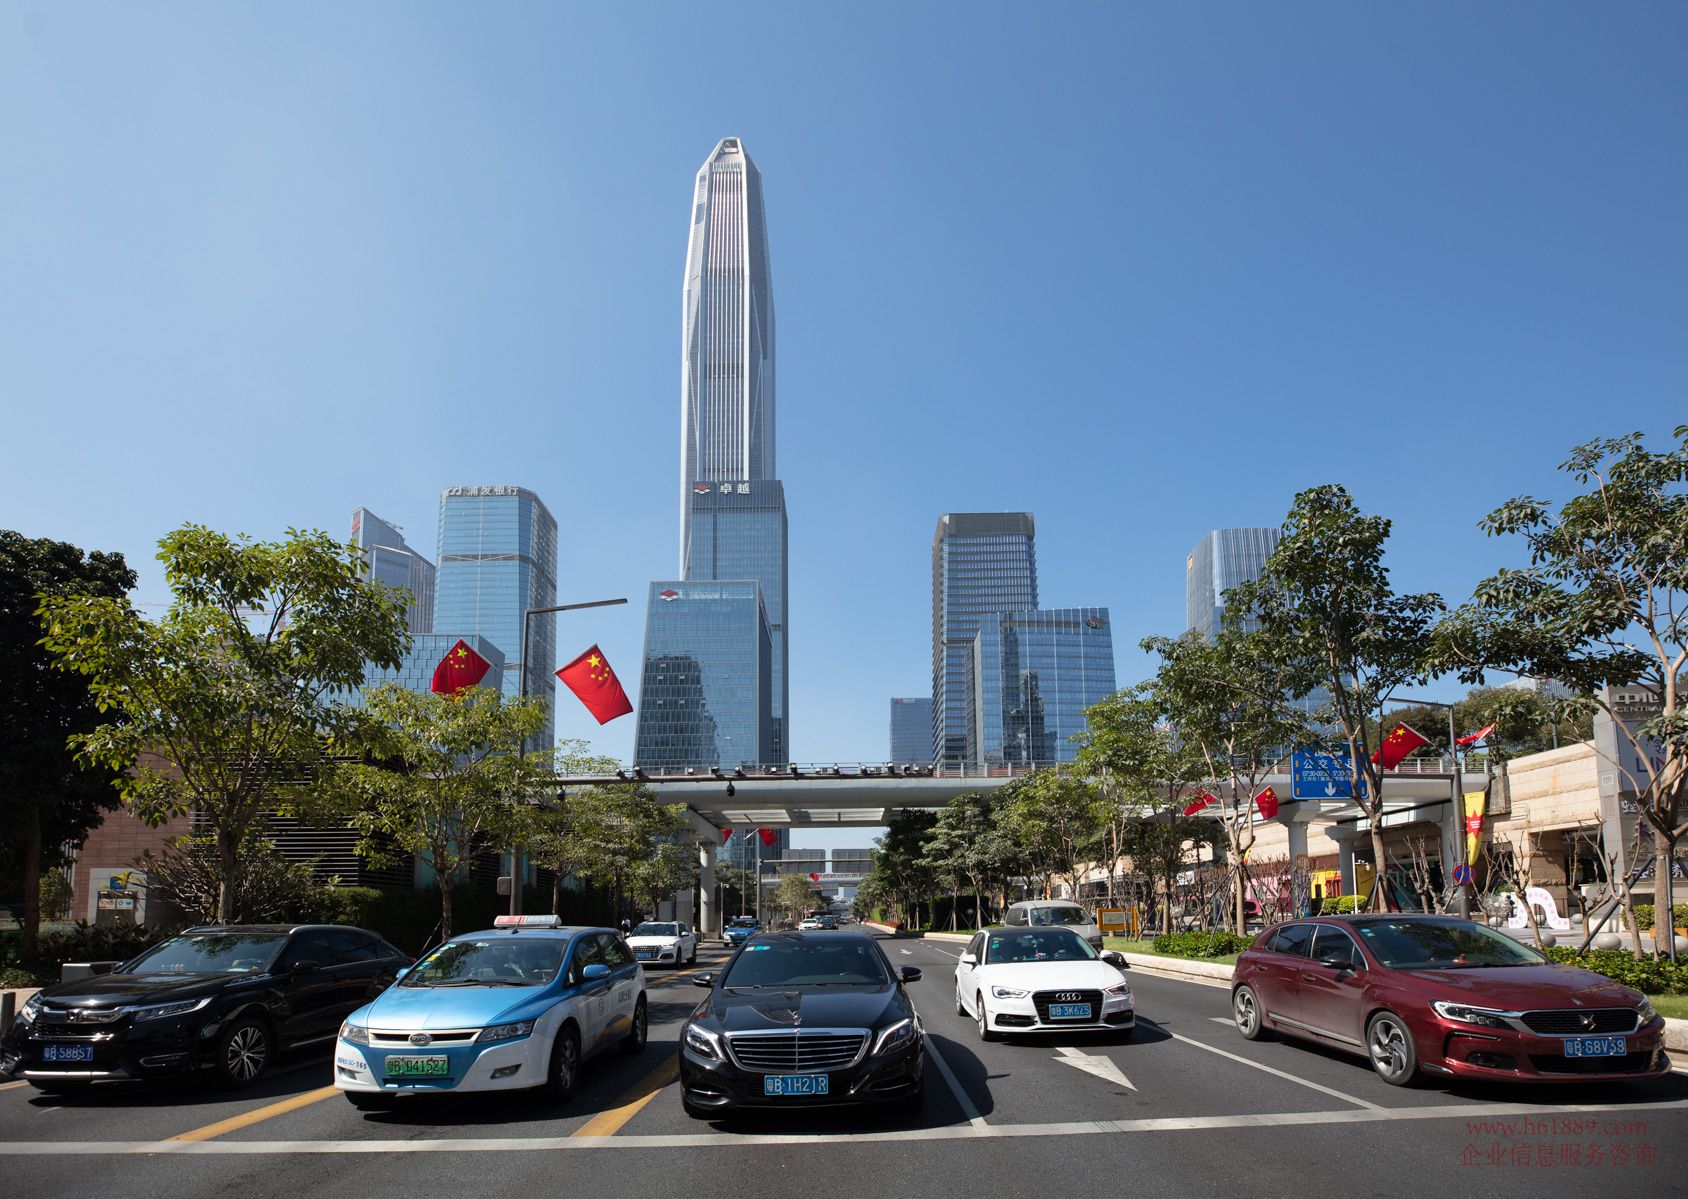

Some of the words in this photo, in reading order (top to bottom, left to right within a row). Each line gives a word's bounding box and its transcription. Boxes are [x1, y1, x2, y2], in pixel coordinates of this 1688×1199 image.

[467, 485, 519, 497] 浦发银行
[719, 483, 750, 495] 卓越
